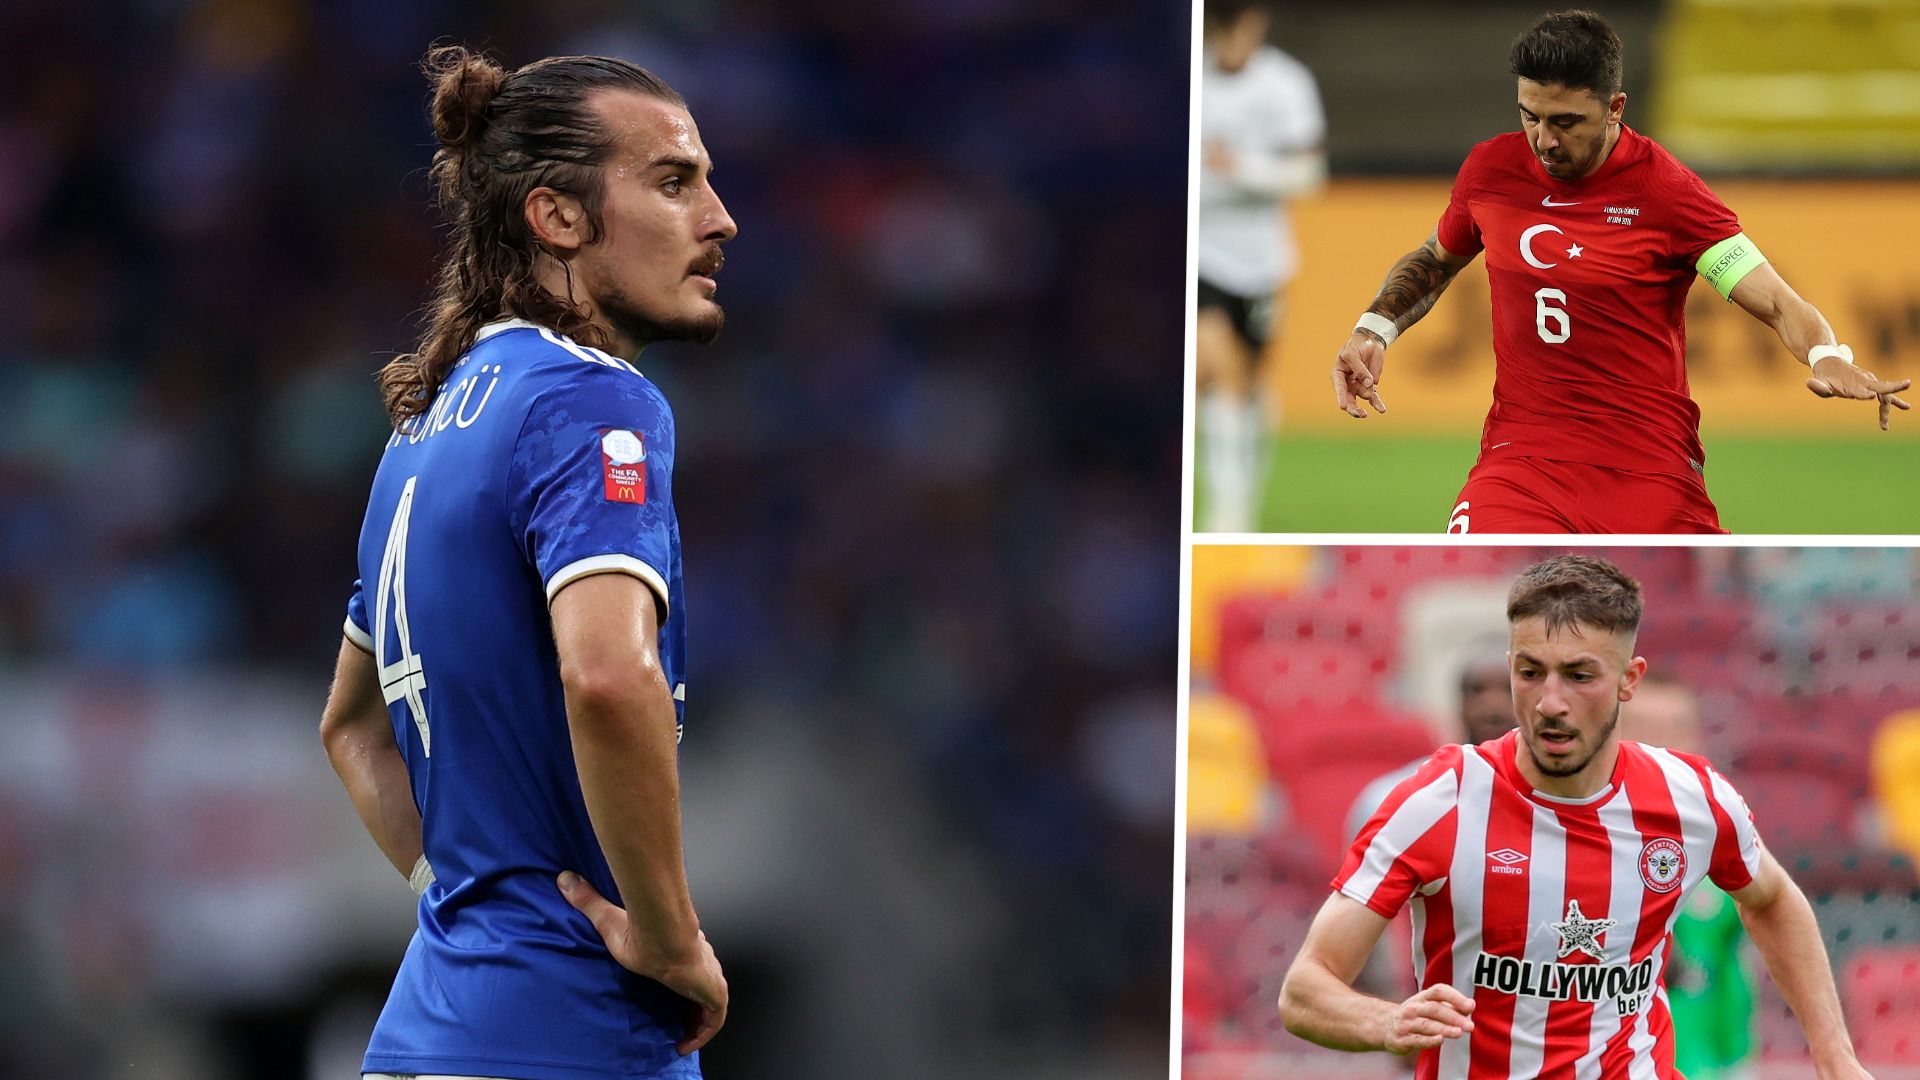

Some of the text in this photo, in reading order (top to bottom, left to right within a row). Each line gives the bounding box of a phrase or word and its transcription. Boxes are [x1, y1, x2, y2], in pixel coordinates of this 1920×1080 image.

[1711, 245, 1746, 277] RESPECT
[1534, 287, 1571, 344] 6
[611, 468, 639, 478] THE FA
[374, 474, 431, 760] 4
[1646, 841, 1681, 856] BRENTFORD
[1491, 864, 1523, 875] umbro
[1473, 953, 1653, 1001] HOLLYWOOD
